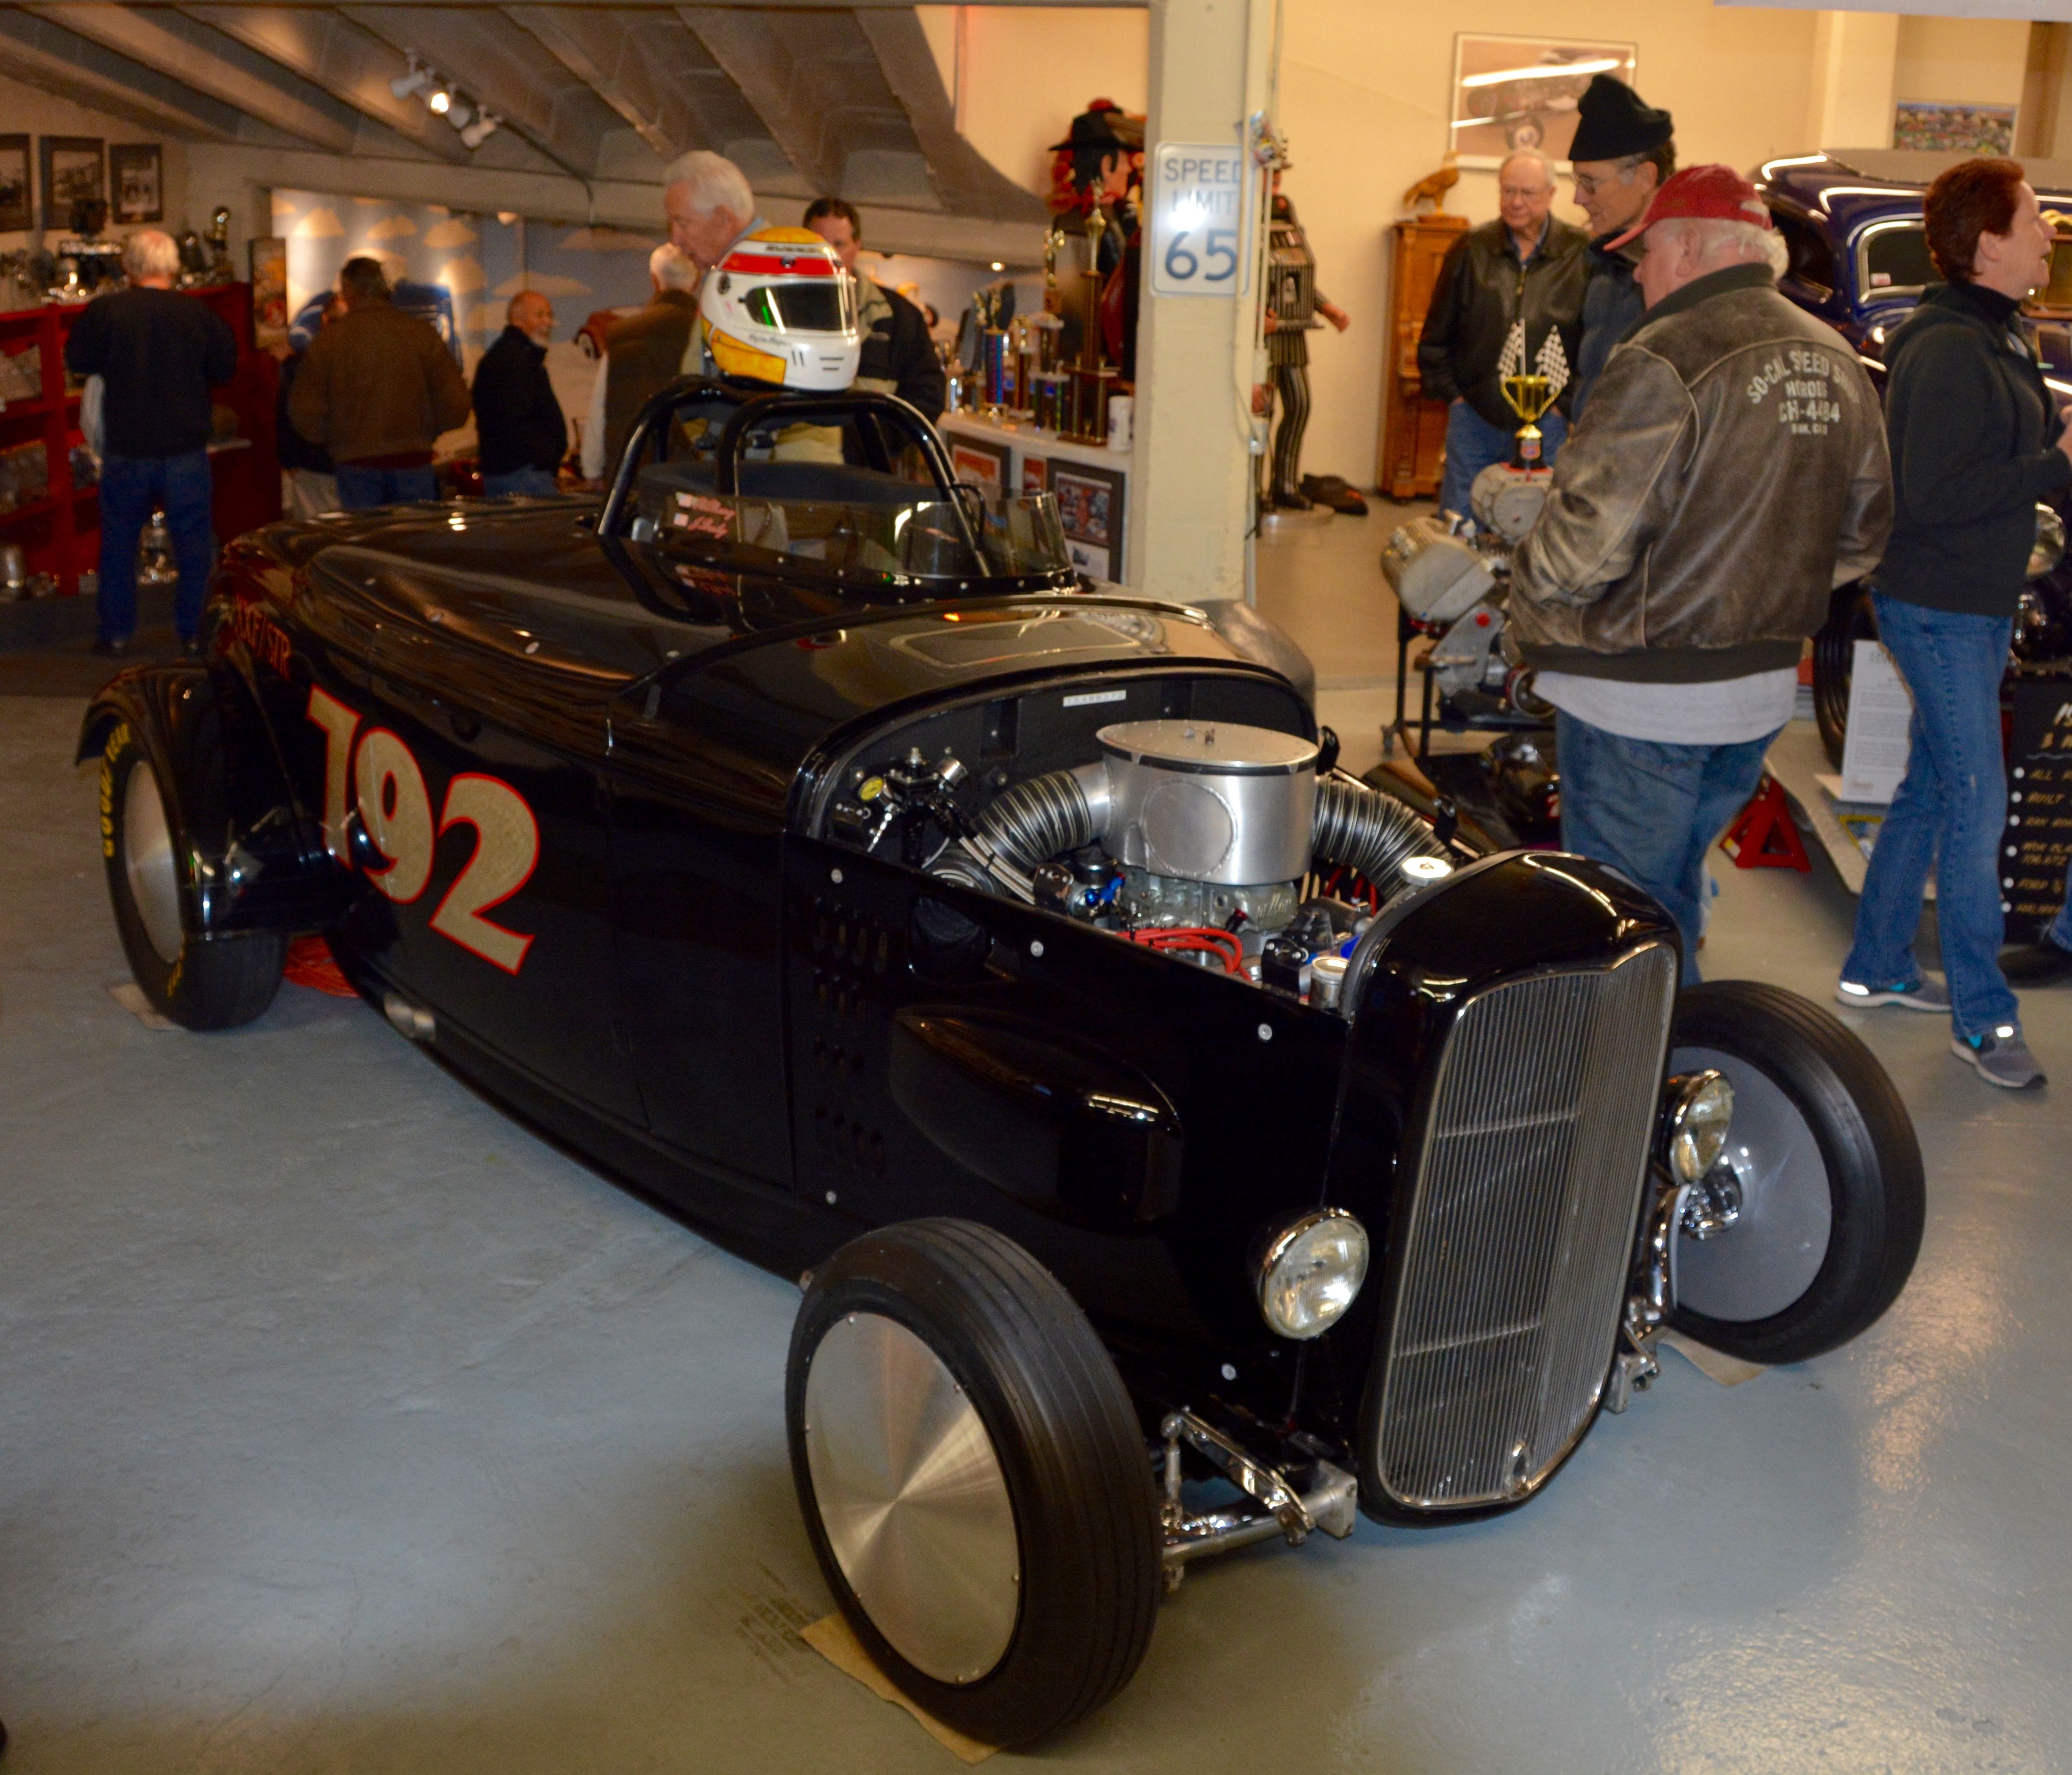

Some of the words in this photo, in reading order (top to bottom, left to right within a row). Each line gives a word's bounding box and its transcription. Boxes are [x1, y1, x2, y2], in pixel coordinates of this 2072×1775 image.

[1165, 158, 1241, 183] SPEED
[1172, 188, 1239, 214] LIMIT
[1165, 229, 1237, 281] 65
[2026, 791, 2065, 806] BUILT
[306, 683, 540, 975] 792
